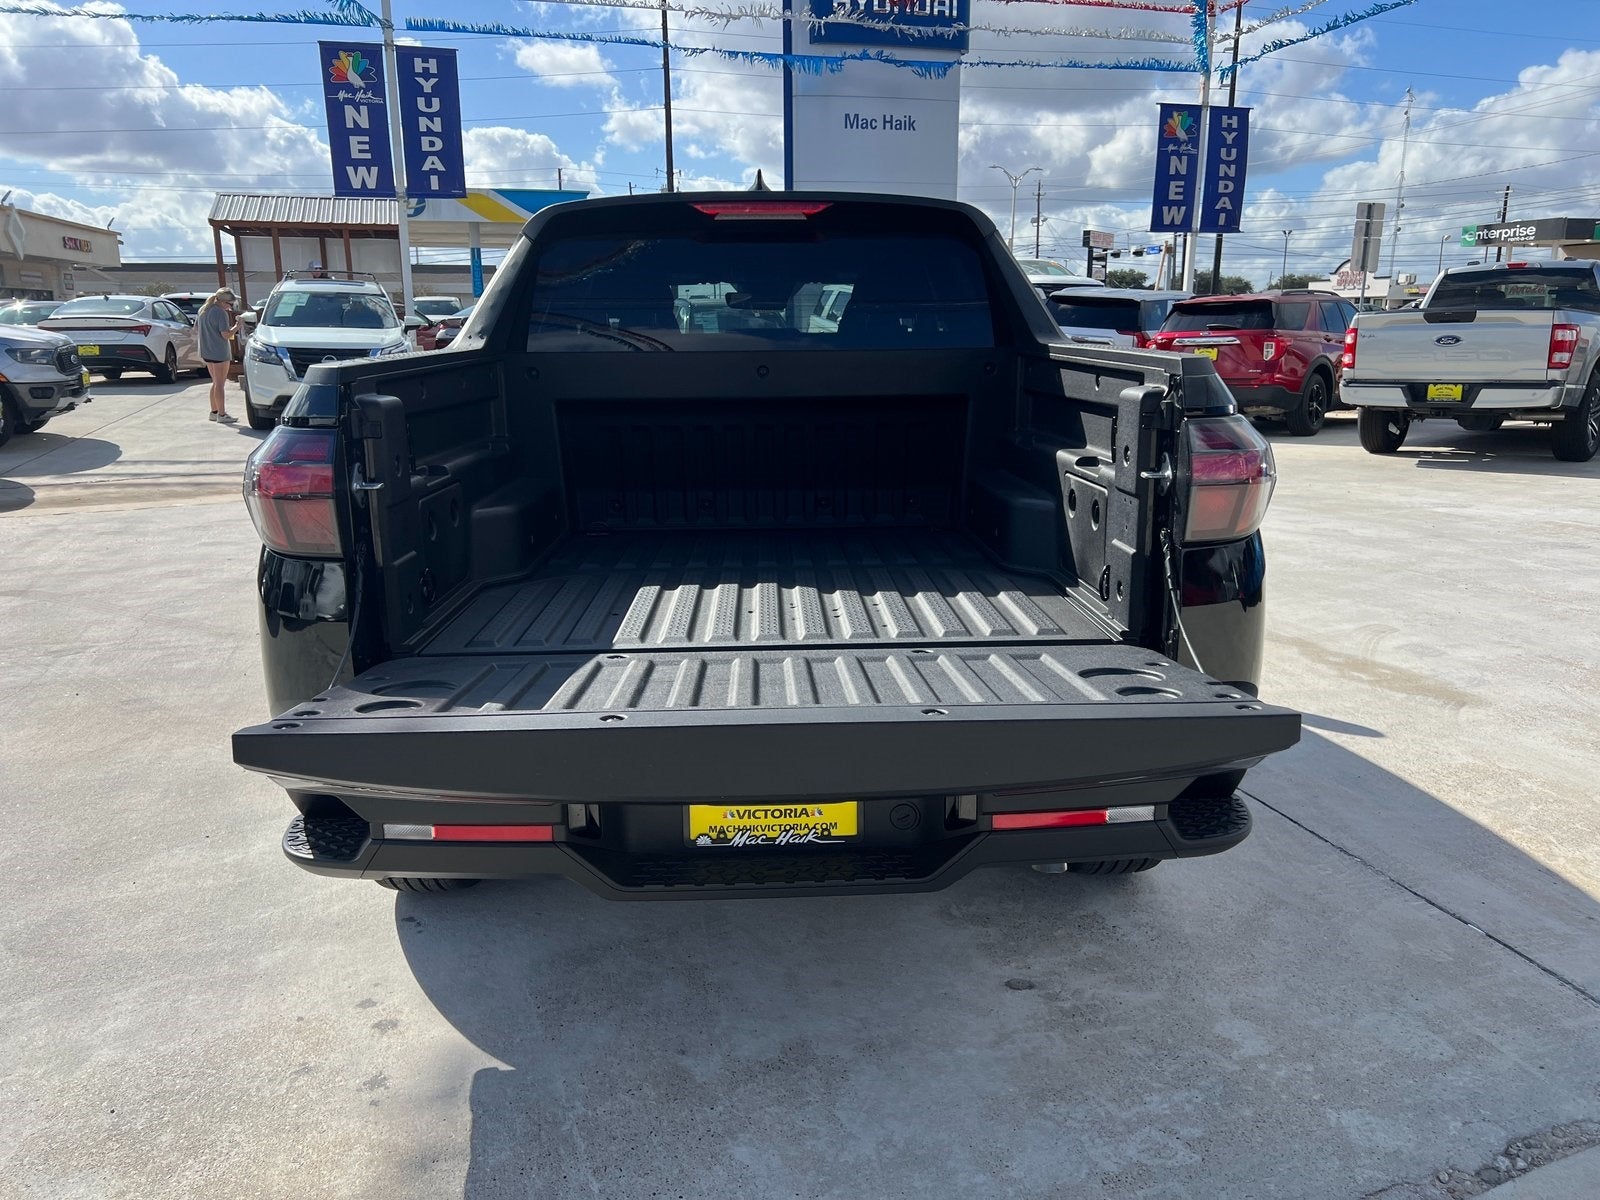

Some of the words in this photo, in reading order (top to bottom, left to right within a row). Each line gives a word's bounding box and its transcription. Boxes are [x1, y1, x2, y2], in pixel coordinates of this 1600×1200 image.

[337, 89, 355, 102] Mac
[355, 89, 374, 103] Haik
[413, 57, 446, 191] HYUNDAI
[844, 113, 878, 130] Mac
[882, 114, 916, 131] Haik
[344, 104, 379, 190] NEW
[1215, 115, 1239, 226] HYUNDAI
[1162, 155, 1188, 225] NEW
[1461, 225, 1536, 242] enterprise
[1439, 336, 1458, 345] Ford
[735, 807, 811, 820] VICTORIA
[708, 821, 838, 835] MACHAIKVICTORIA.COM
[728, 829, 774, 847] Mac
[774, 828, 822, 846] Haik
